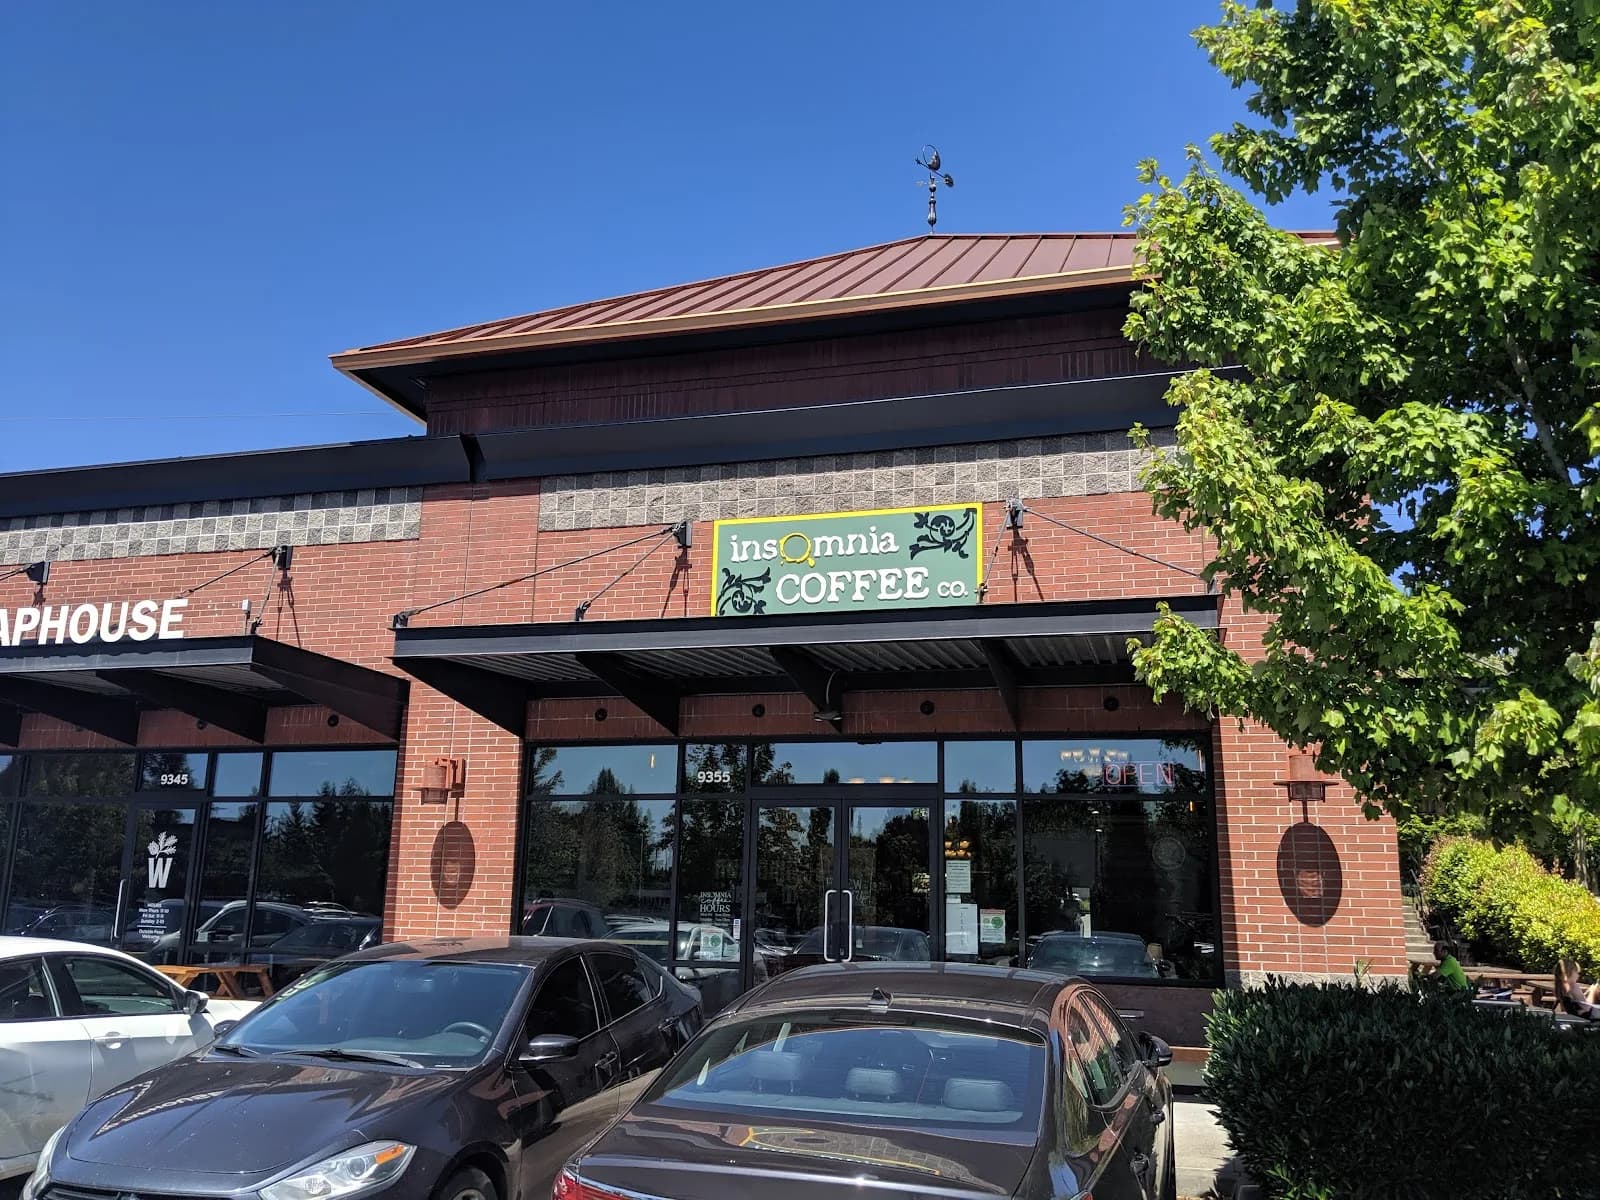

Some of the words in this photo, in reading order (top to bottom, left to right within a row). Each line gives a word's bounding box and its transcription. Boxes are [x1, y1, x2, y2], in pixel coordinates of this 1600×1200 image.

[775, 566, 930, 605] COFFEE
[160, 774, 188, 785] 9345
[697, 770, 731, 783] 9355
[1105, 763, 1173, 785] OPEN
[148, 857, 173, 889] W
[700, 904, 731, 913] HOURS
